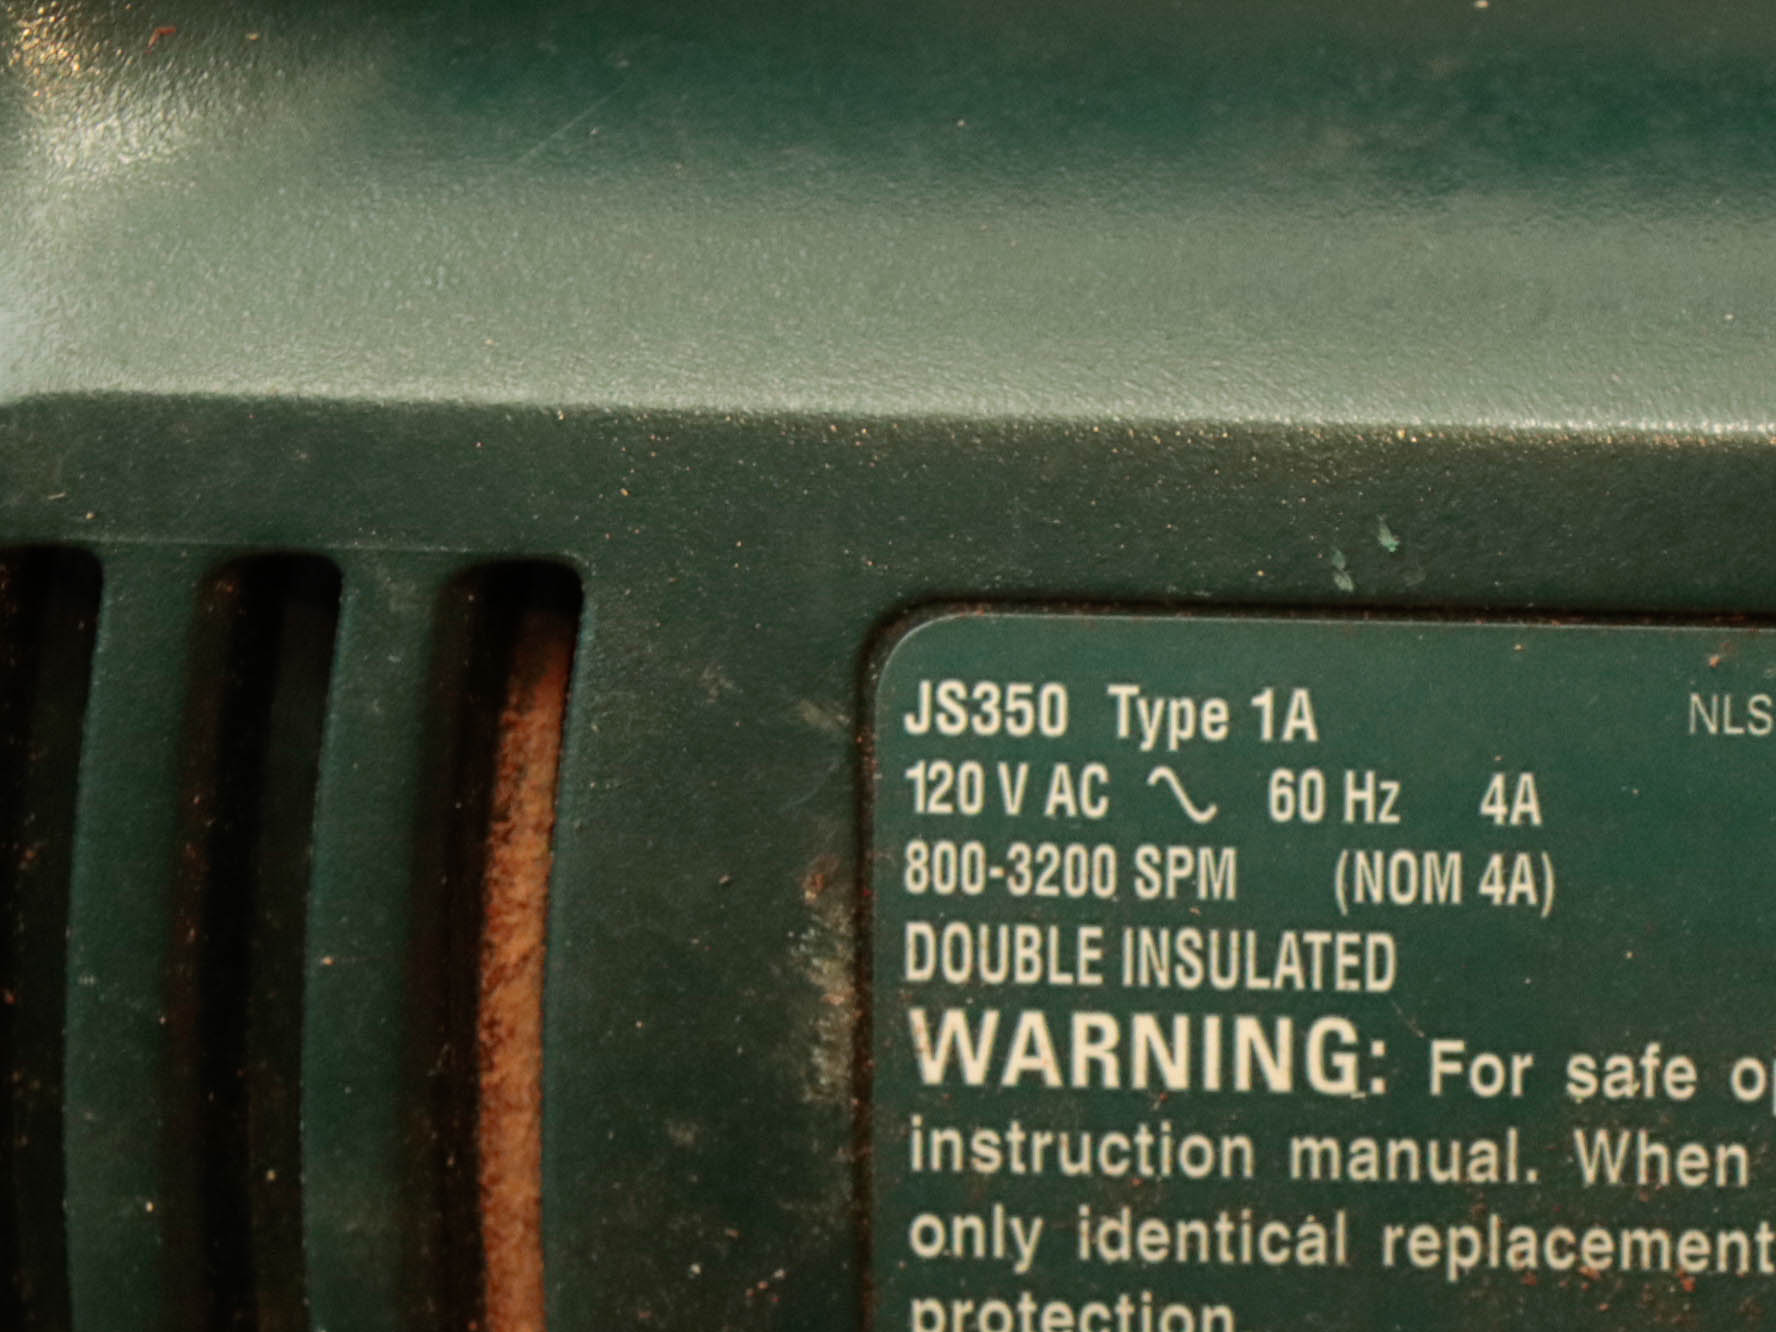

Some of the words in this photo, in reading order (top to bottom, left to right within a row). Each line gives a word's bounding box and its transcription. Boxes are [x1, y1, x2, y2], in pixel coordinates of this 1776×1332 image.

[903, 679, 1068, 738] JS350
[1107, 684, 1229, 752] Type
[1251, 687, 1318, 742] 1A
[1689, 692, 1773, 737] NLS
[905, 760, 984, 816] 120
[997, 761, 1029, 816] V
[1044, 762, 1109, 819] AC
[1268, 767, 1325, 823] 60
[1343, 769, 1400, 824] Hz
[1480, 772, 1542, 826] 4A
[903, 839, 1117, 899] 800-3200
[1134, 844, 1236, 900] SPM
[1334, 849, 1462, 914] (NOM
[1478, 852, 1555, 917] 4A)
[905, 921, 1103, 986] DOUBLE
[1122, 927, 1396, 993] INSULATED
[908, 1007, 1385, 1098] WARNING:
[1430, 1039, 1533, 1098] For
[1566, 1042, 1697, 1103] safe
[910, 1114, 1254, 1179] instruction
[1290, 1127, 1538, 1184] manual.
[1573, 1128, 1749, 1188] When
[909, 1203, 1043, 1274] only
[1078, 1204, 1346, 1266] identical
[1382, 1213, 1776, 1283] replacement
